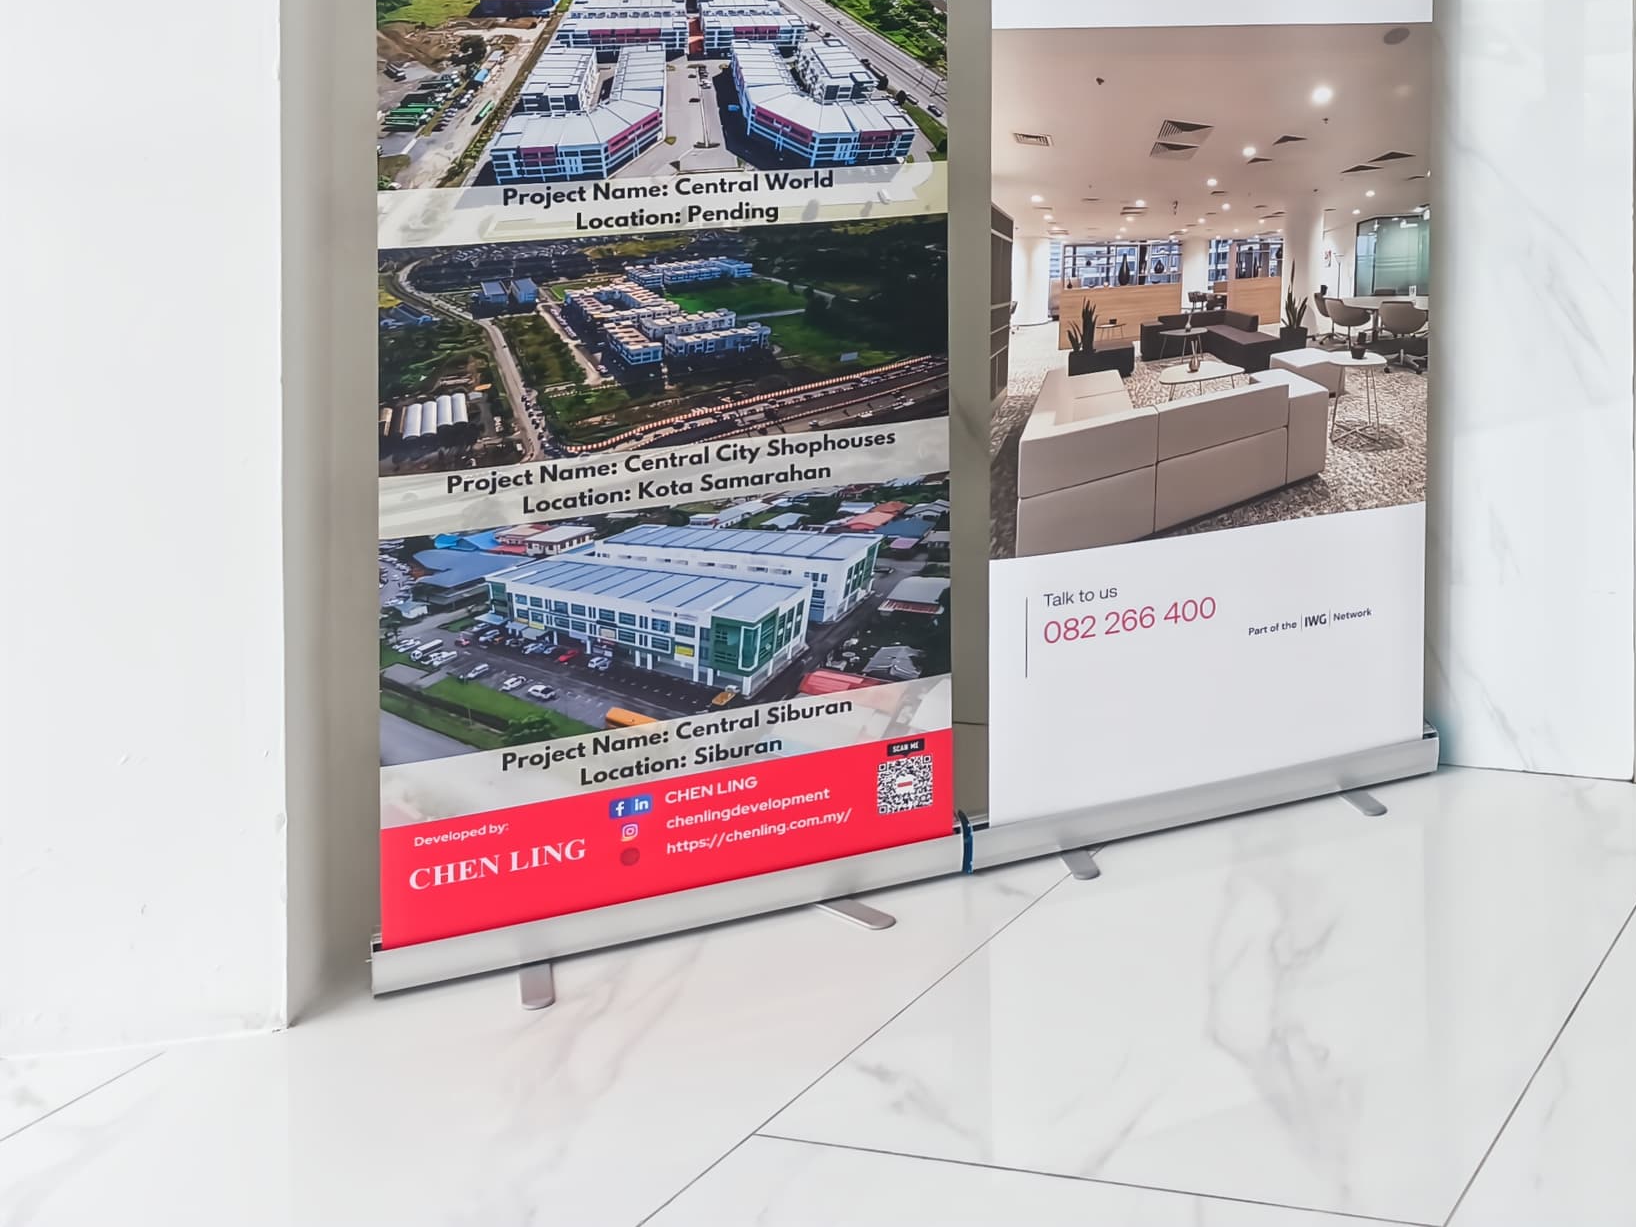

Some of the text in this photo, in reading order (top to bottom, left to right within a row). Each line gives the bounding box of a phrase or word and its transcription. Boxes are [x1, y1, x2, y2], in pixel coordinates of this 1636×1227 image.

[502, 171, 834, 210] Project Name: Central World
[575, 203, 779, 231] Location: Pending
[447, 429, 896, 495] Project Name: Central City Shophouses
[522, 464, 831, 515] Location: Kota Samarahan
[1043, 586, 1118, 608] Talk to us
[1043, 596, 1217, 645] 082 266 400
[1248, 607, 1373, 636] Part of the IWG Network
[501, 698, 853, 773] Project Name: Central Siburan
[892, 741, 920, 753] SCAN ME
[580, 737, 783, 786] Location: Siburan
[664, 775, 758, 805] CHEN LING
[665, 787, 830, 830] chenlingdevelopment
[414, 822, 510, 848] Developed by:
[665, 807, 853, 856] https://chenling.com.my/
[408, 839, 586, 891] CHEN LING
